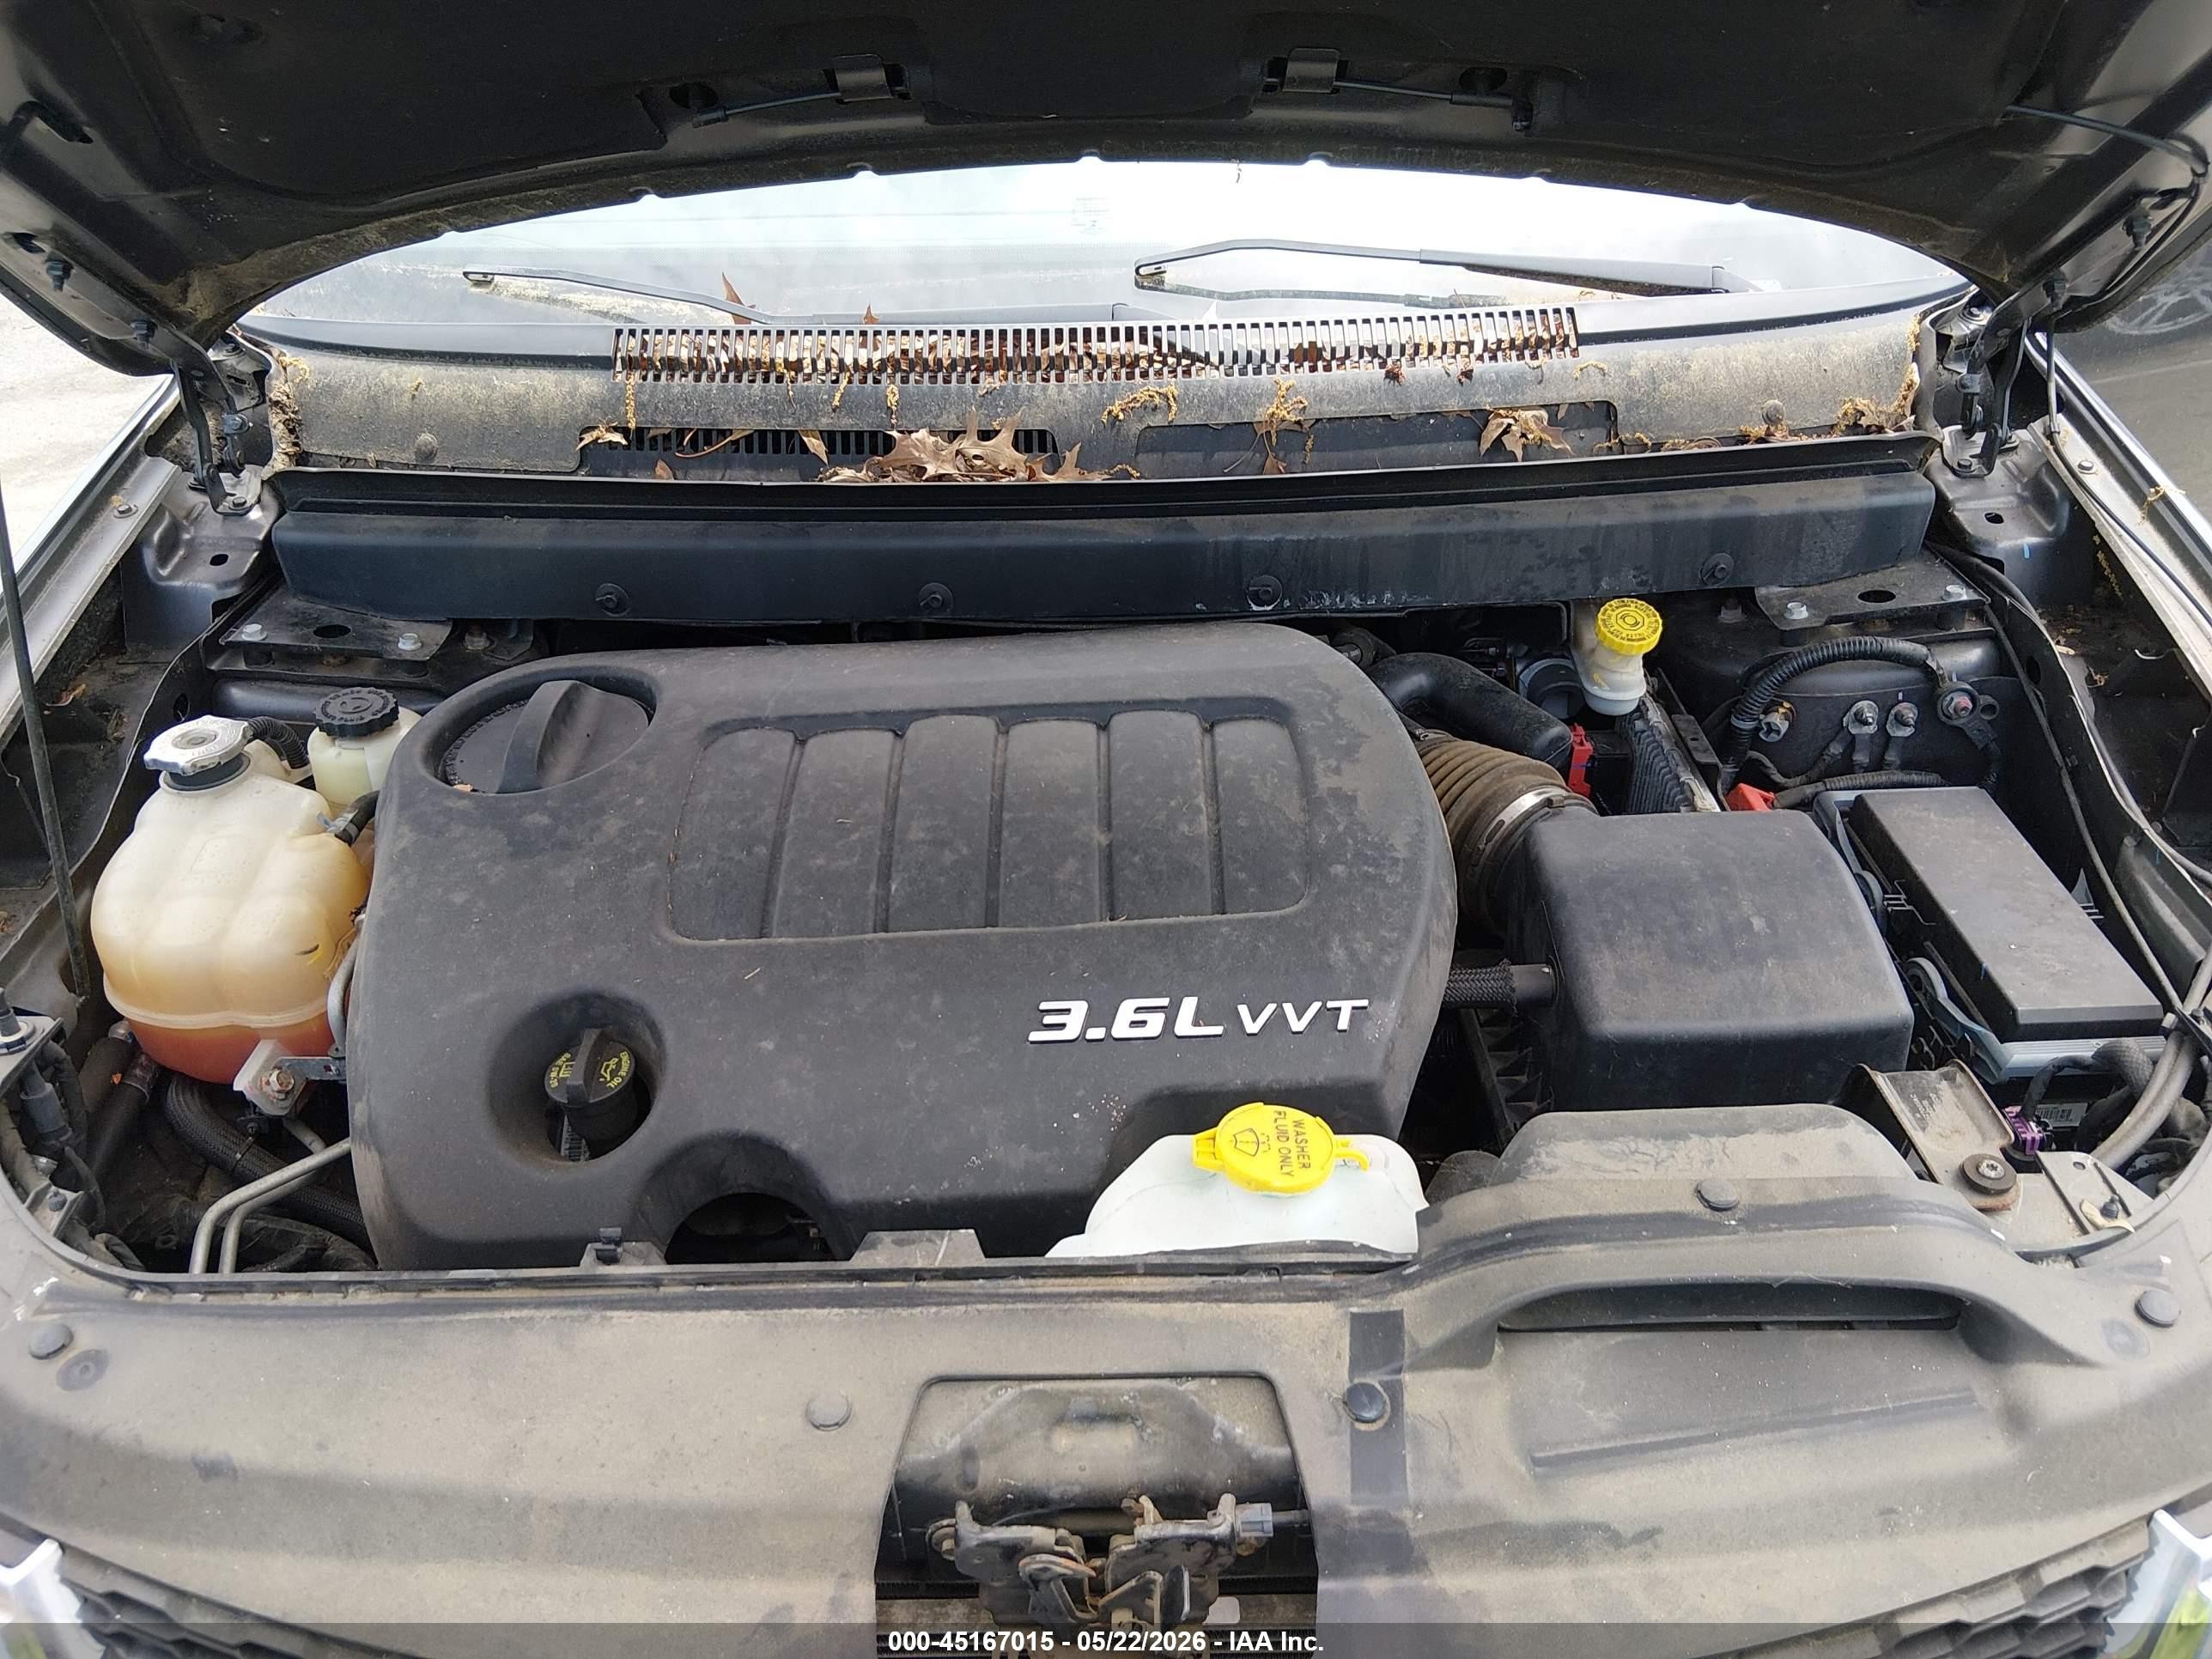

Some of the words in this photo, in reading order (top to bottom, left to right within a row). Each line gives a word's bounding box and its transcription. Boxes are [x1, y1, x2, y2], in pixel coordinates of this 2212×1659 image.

[1028, 996, 1224, 1042] 3.6L
[1237, 999, 1370, 1034] VVT
[619, 1050, 630, 1078] ENGINE
[605, 1076, 623, 1089] OIL
[1272, 1110, 1290, 1144] FLUID
[1291, 1119, 1312, 1169] WASHER
[1278, 1146, 1295, 1177] ONLY
